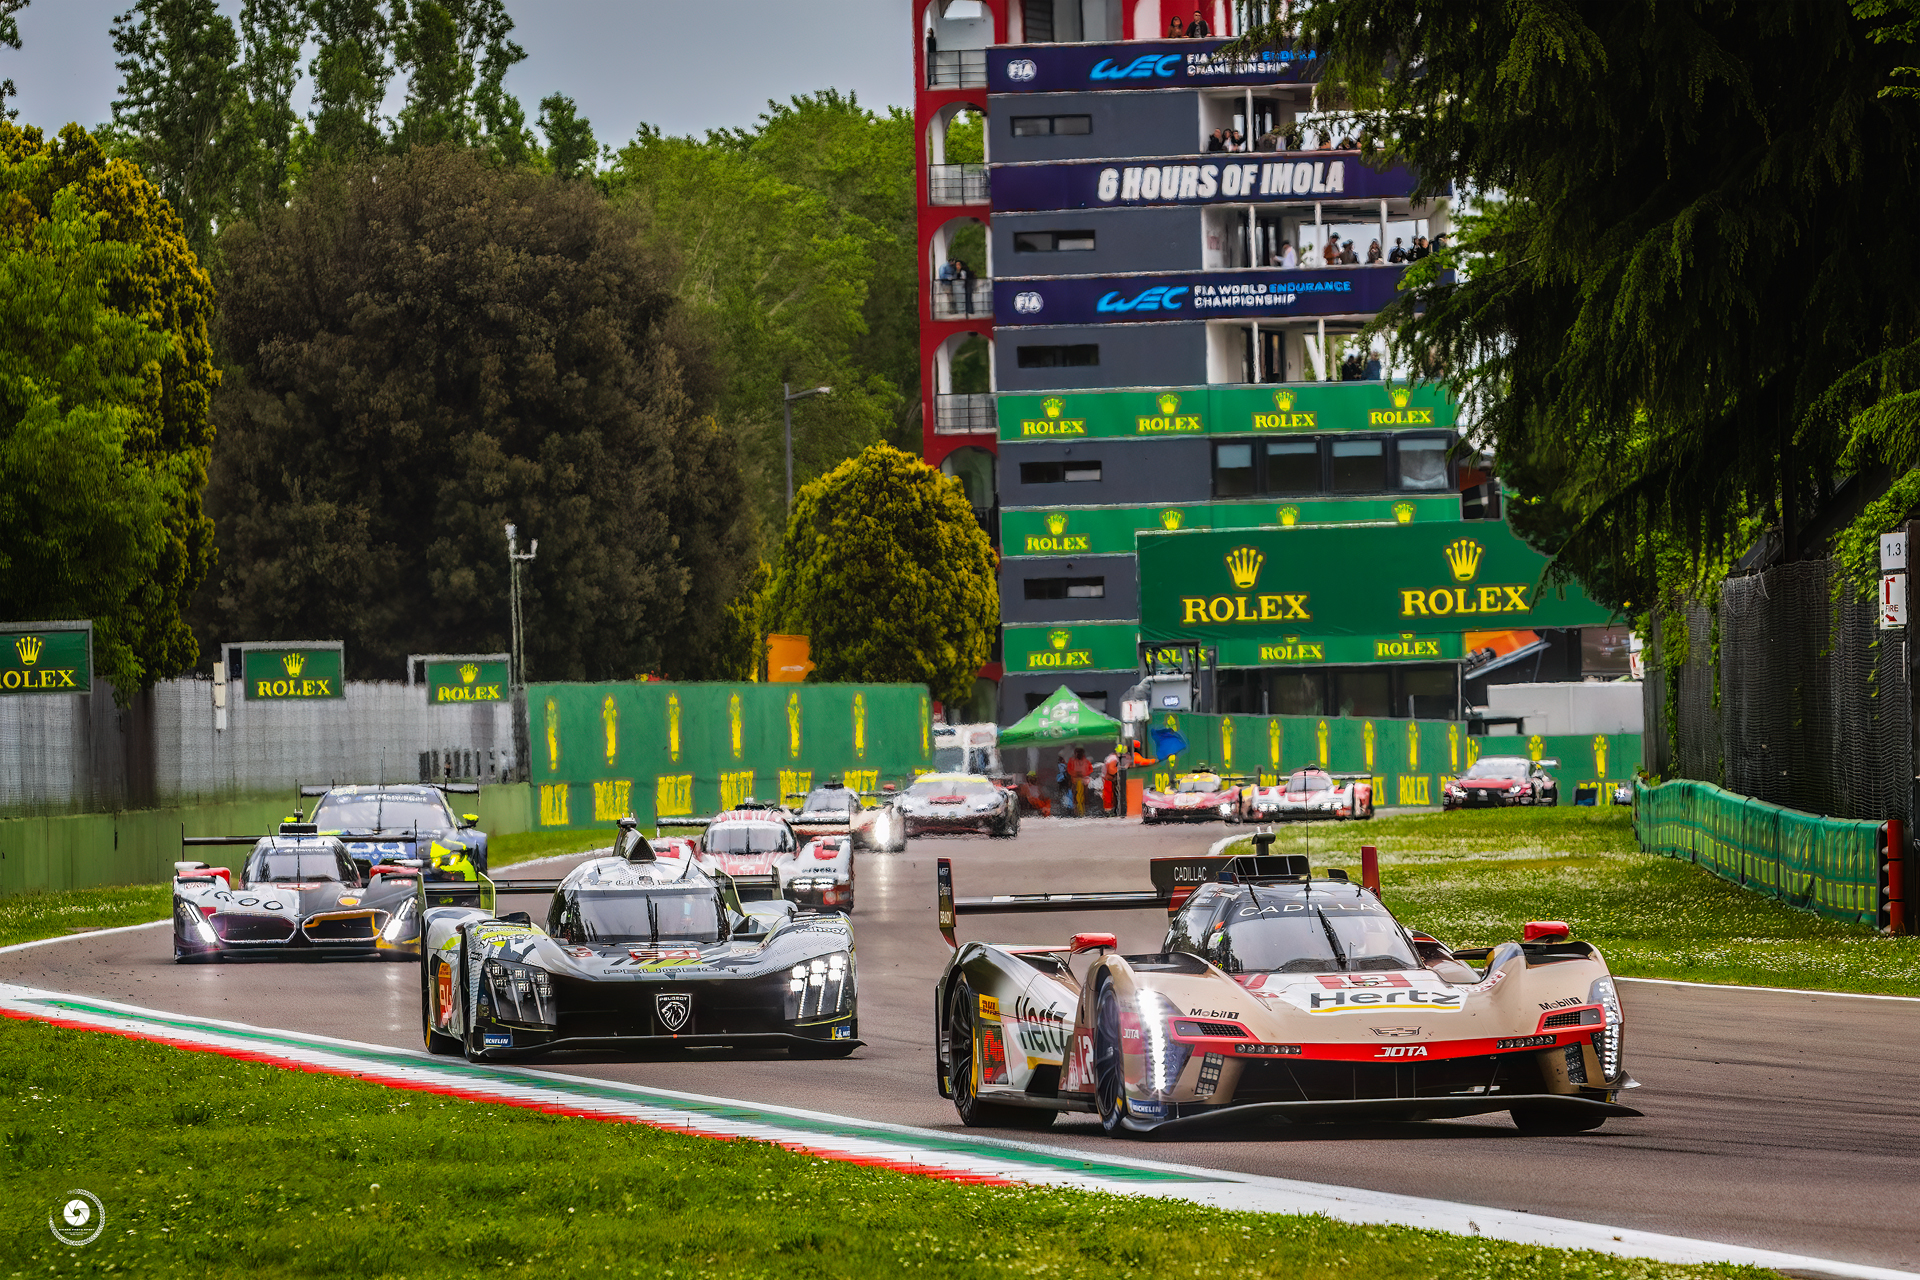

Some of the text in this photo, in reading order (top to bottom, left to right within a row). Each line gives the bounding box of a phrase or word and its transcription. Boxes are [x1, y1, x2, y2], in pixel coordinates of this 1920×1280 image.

[1089, 53, 1181, 80] WEC
[1187, 53, 1208, 64] FIA
[1098, 161, 1345, 202] 6 HOURS OF IMOLA
[1194, 281, 1351, 296] FIA WORLD ENDURANCE
[1097, 286, 1189, 313] WEC
[1194, 294, 1297, 308] CHAMPIONSHIP
[1138, 417, 1200, 432] ROLEX
[1254, 413, 1316, 428] ROLEX
[1370, 410, 1432, 425] ROLEX
[1023, 420, 1085, 436] ROLEX
[1027, 535, 1089, 552] ROLEX
[1886, 543, 1901, 556] 1.3
[1182, 594, 1311, 624] ROLEX
[1401, 585, 1530, 617] ROLEX
[1885, 604, 1899, 613] FIRE
[1260, 644, 1323, 662] ROLEX
[1376, 639, 1439, 658] ROLEX
[1029, 650, 1091, 668] ROLEX
[0, 669, 76, 689] OLEX
[257, 680, 331, 697] ROLEX
[437, 684, 501, 701] ROLEX
[1174, 867, 1207, 881] CADILLAC
[1239, 902, 1387, 917] CADILLAC
[634, 951, 698, 959] 94
[1310, 990, 1460, 1008] Hertz
[1015, 996, 1067, 1055] Hertz
[1123, 1028, 1139, 1039] JOTA
[1078, 1035, 1095, 1084] 12
[1374, 1046, 1428, 1057] JOTA
